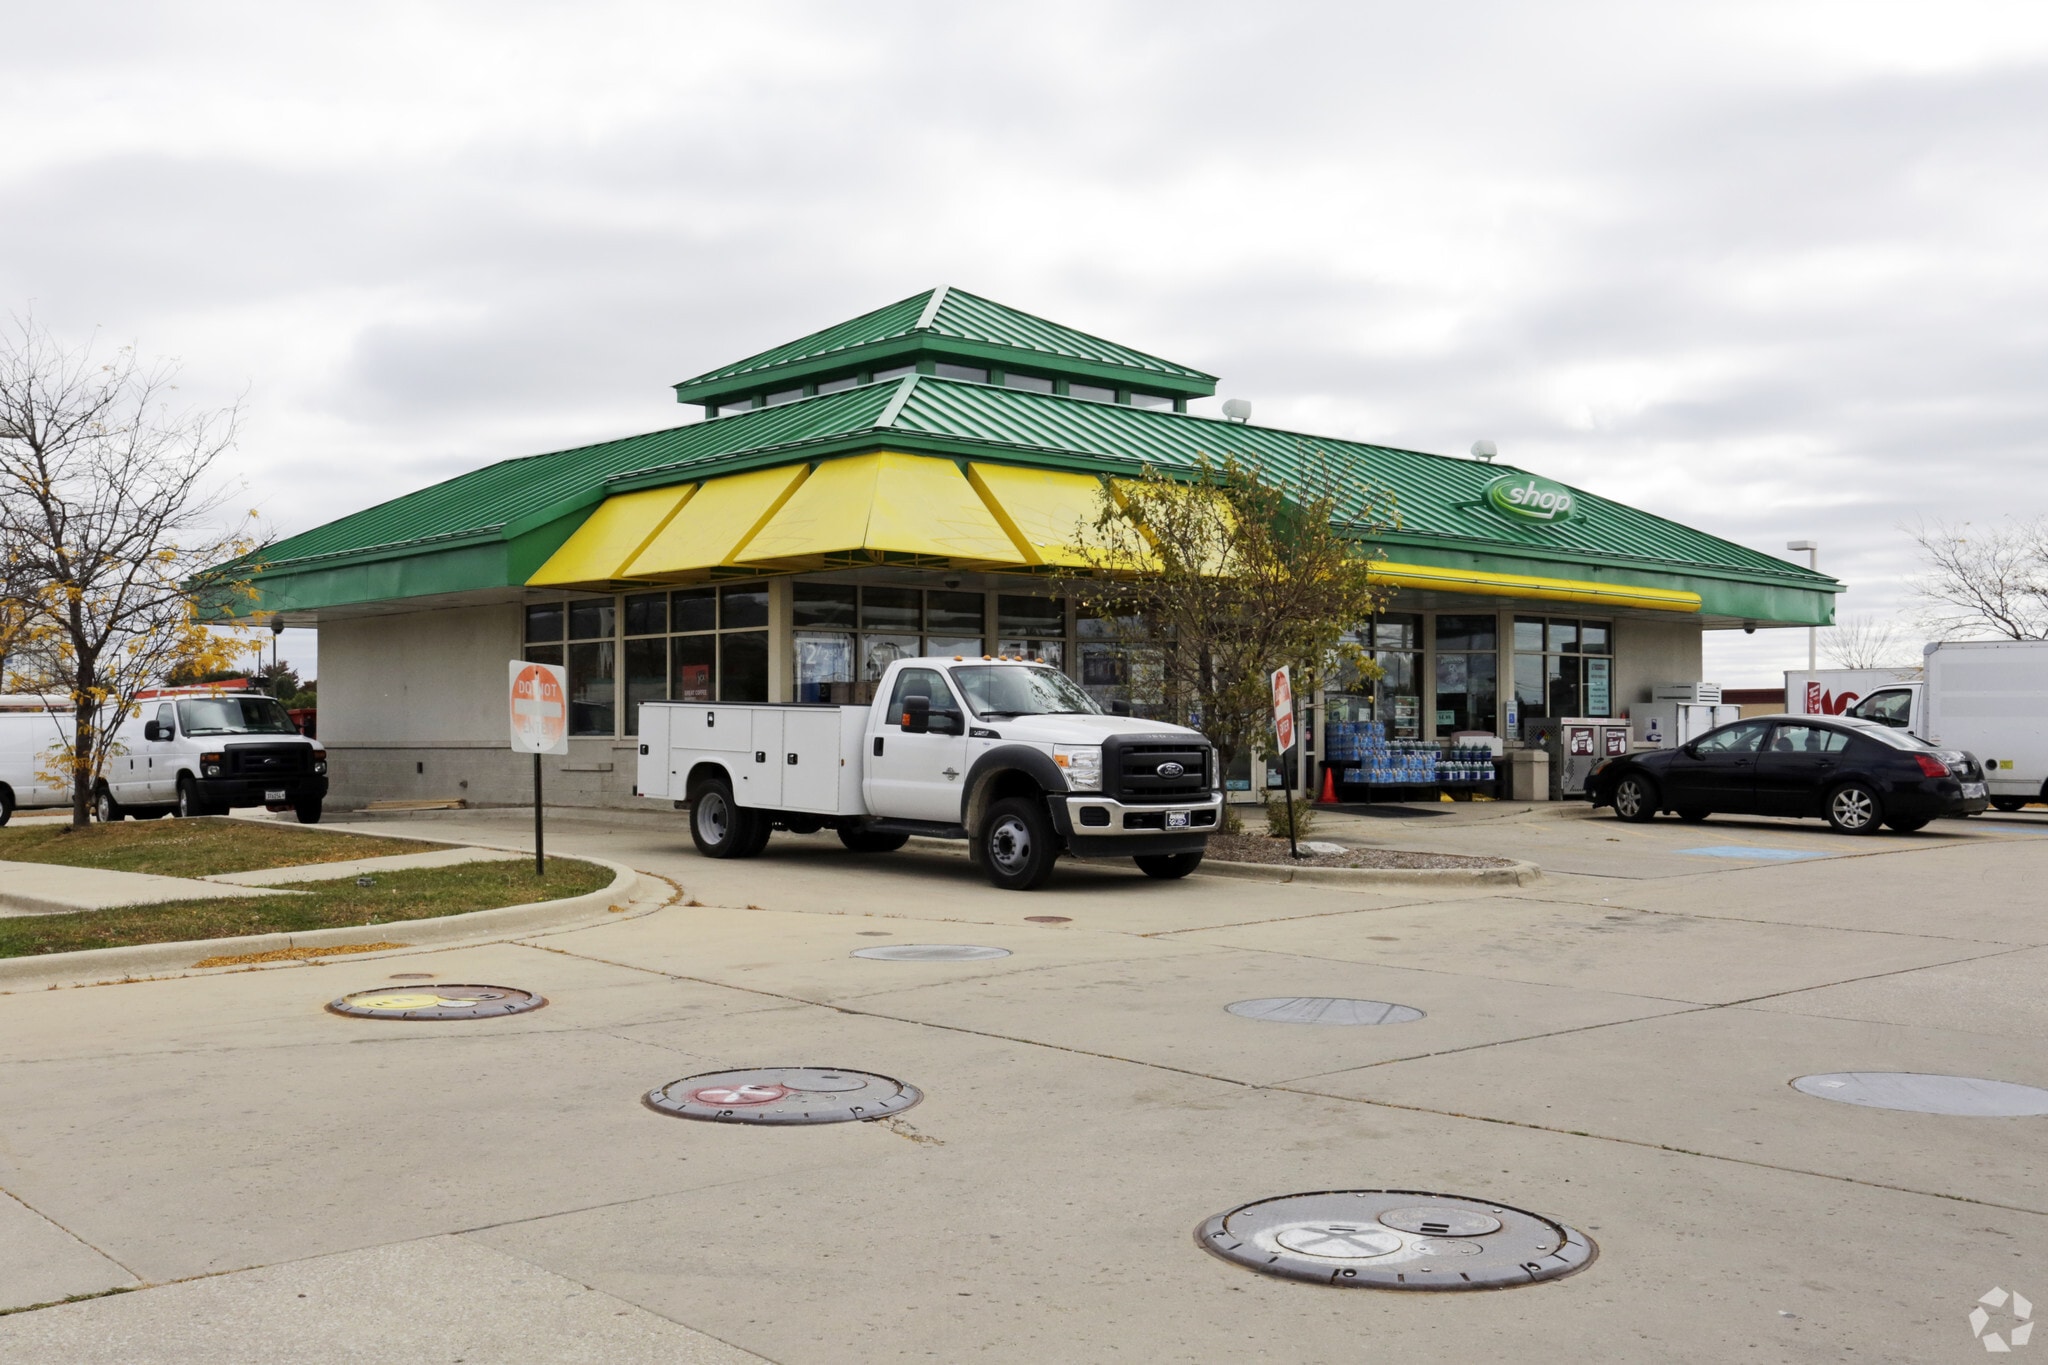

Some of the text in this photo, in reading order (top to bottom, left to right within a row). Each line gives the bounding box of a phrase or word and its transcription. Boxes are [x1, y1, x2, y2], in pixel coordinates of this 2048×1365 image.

[1510, 481, 1571, 520] shop
[519, 681, 532, 694] DO
[1164, 764, 1180, 775] Ford
